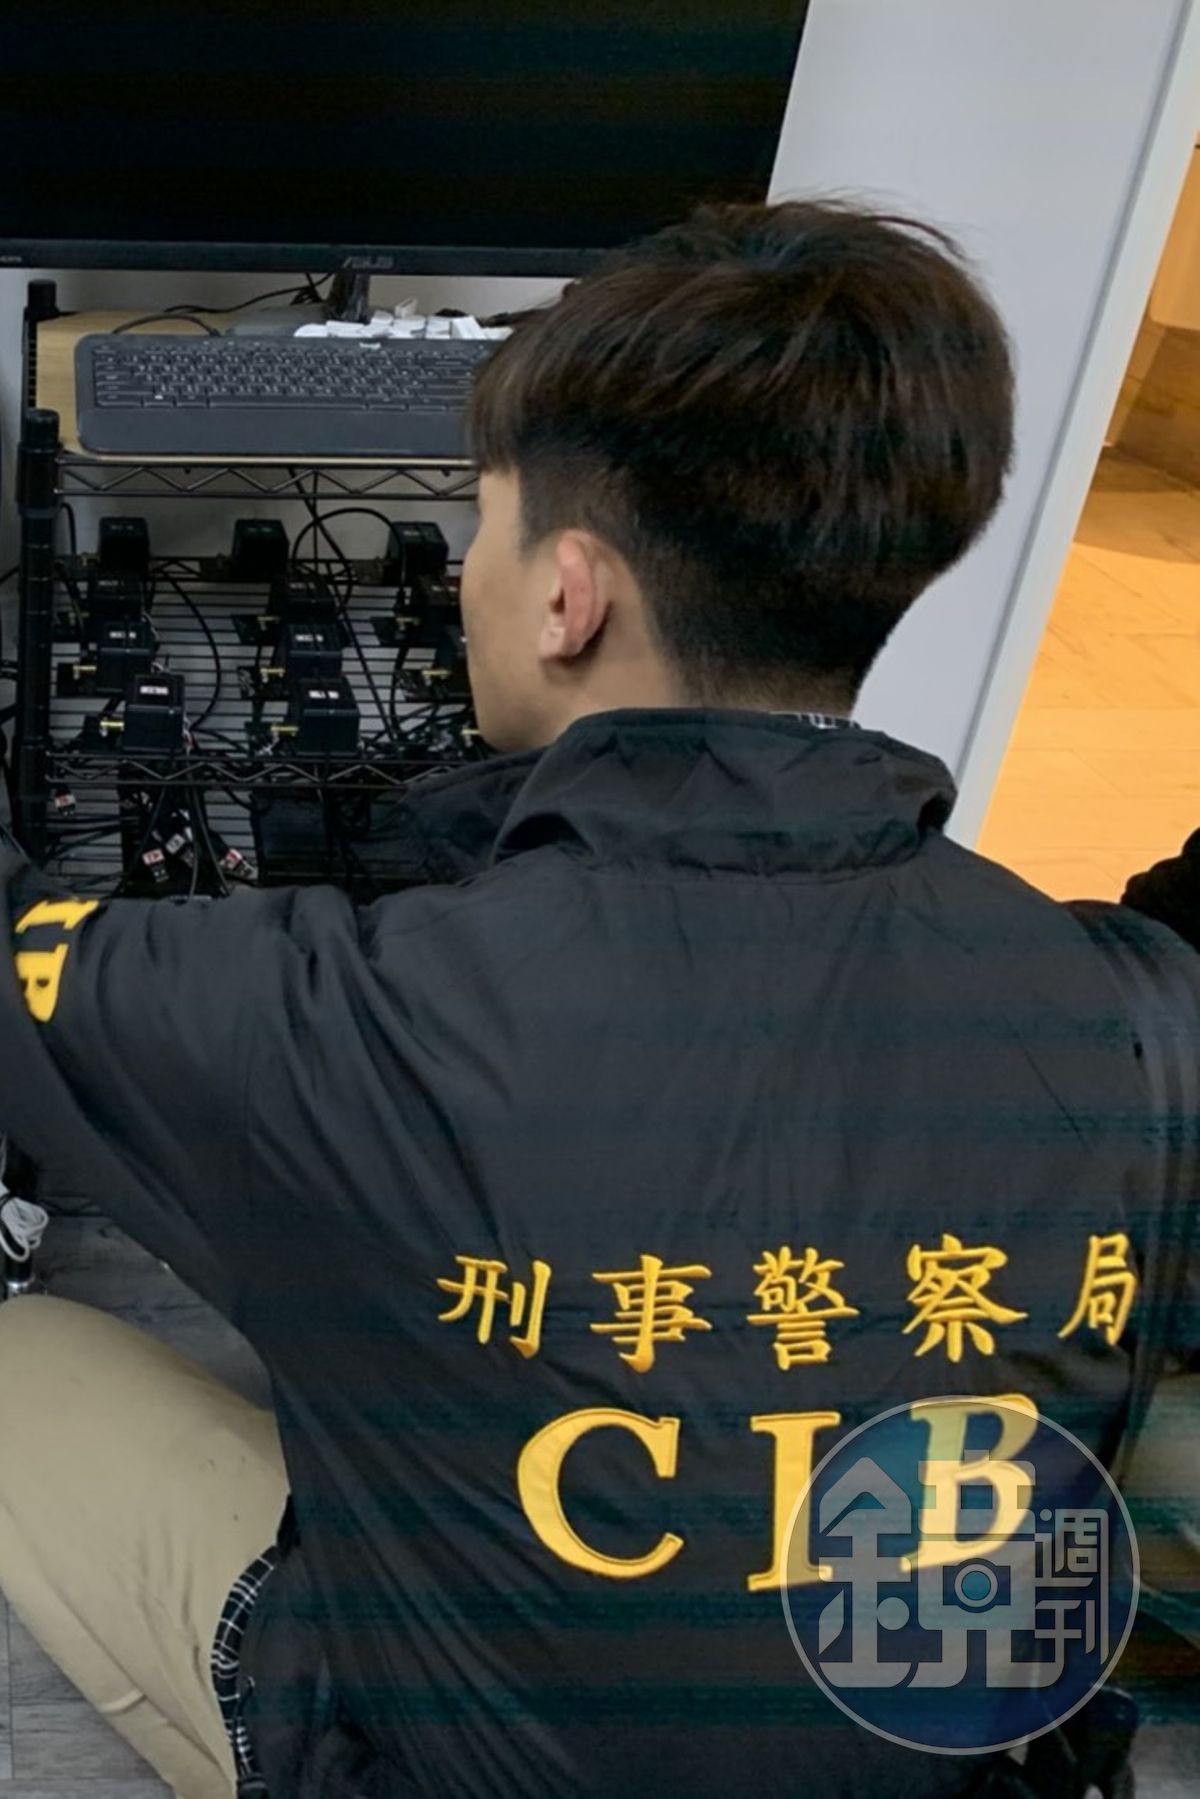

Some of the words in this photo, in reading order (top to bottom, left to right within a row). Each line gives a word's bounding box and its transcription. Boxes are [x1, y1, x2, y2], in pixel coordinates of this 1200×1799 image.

[341, 255, 395, 270] ASUS
[436, 1231, 1139, 1373] 刑事警察局
[516, 1392, 1039, 1592] CIB
